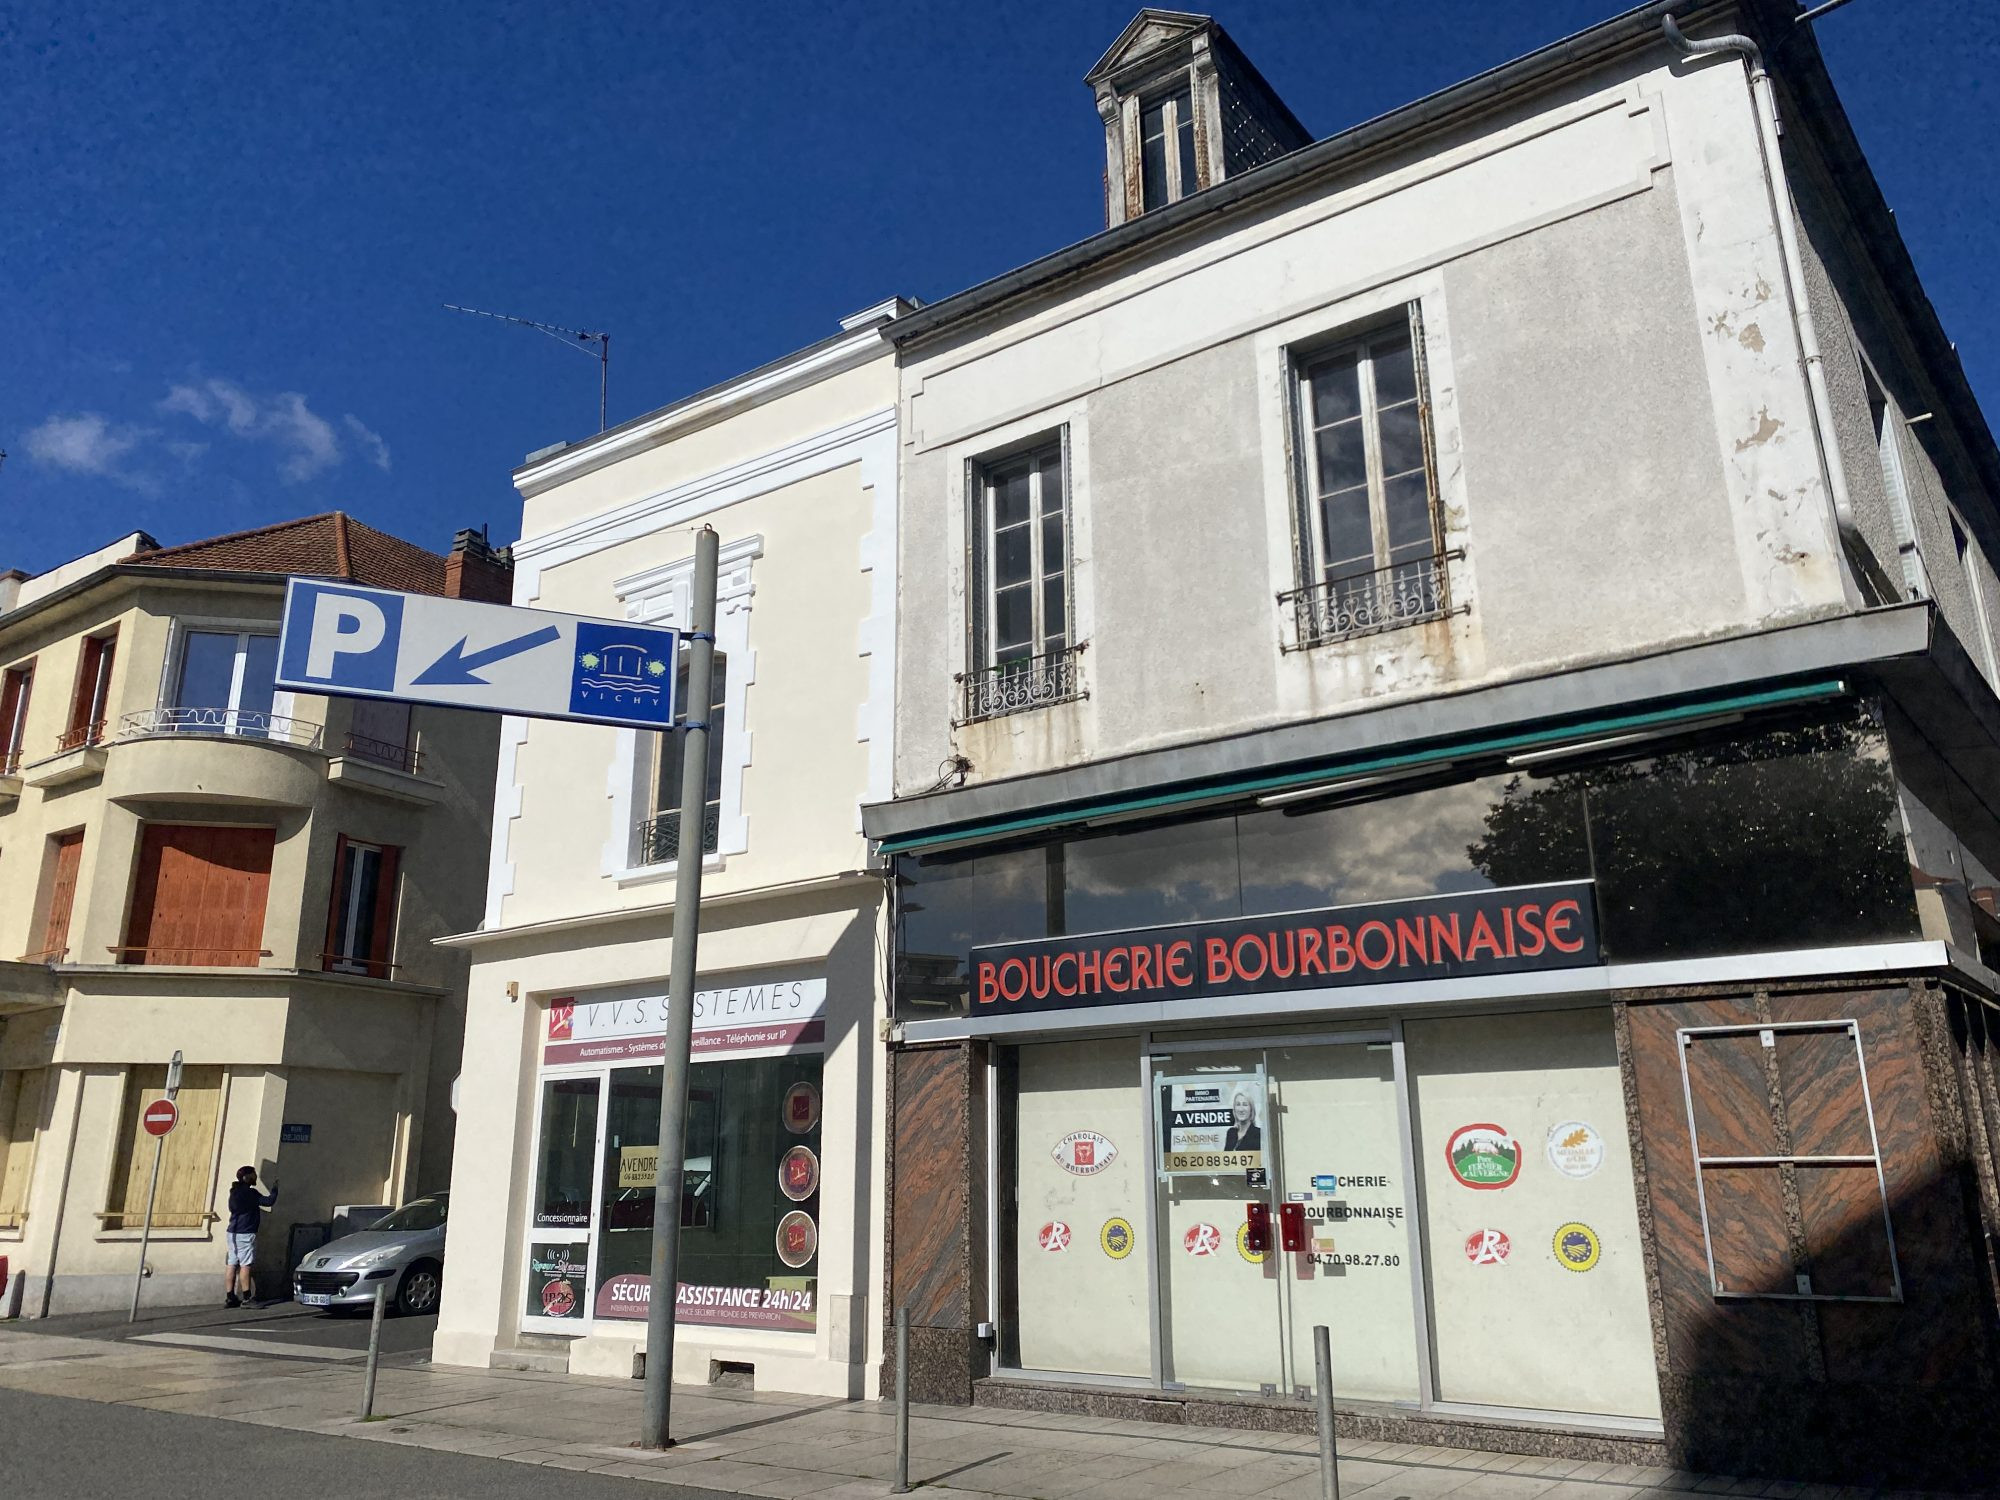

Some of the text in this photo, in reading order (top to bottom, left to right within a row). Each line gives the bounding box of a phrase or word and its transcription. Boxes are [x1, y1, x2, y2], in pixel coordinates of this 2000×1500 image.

[305, 592, 386, 680] P
[581, 690, 661, 707] VICHY
[978, 899, 1585, 1004] BOUCHERIE BOURBONNAISE
[659, 982, 803, 1021] SSTEMES
[580, 1045, 624, 1057] Automatismes
[628, 1042, 658, 1054] Systèmes
[692, 1036, 721, 1047] veillance
[726, 1031, 766, 1046] Téléphonie
[767, 1032, 778, 1041] sur
[779, 1029, 787, 1039] IP
[1175, 1112, 1231, 1124] A VENDRE
[1063, 1133, 1104, 1145] CHAROLAIS
[1175, 1134, 1219, 1144] SANDRINE
[1065, 1151, 1114, 1174] BOURBONNAIS
[1173, 1155, 1253, 1167] 06 20 88 94 87
[1310, 1176, 1387, 1188] BCHERIE
[537, 1213, 588, 1224] Concessionnaire
[1303, 1207, 1404, 1219] OURBONNAISE
[1306, 1254, 1400, 1266] 04.70.98.27.80
[611, 1279, 812, 1311] SÉCUR ASSISTANCE 24h/24
